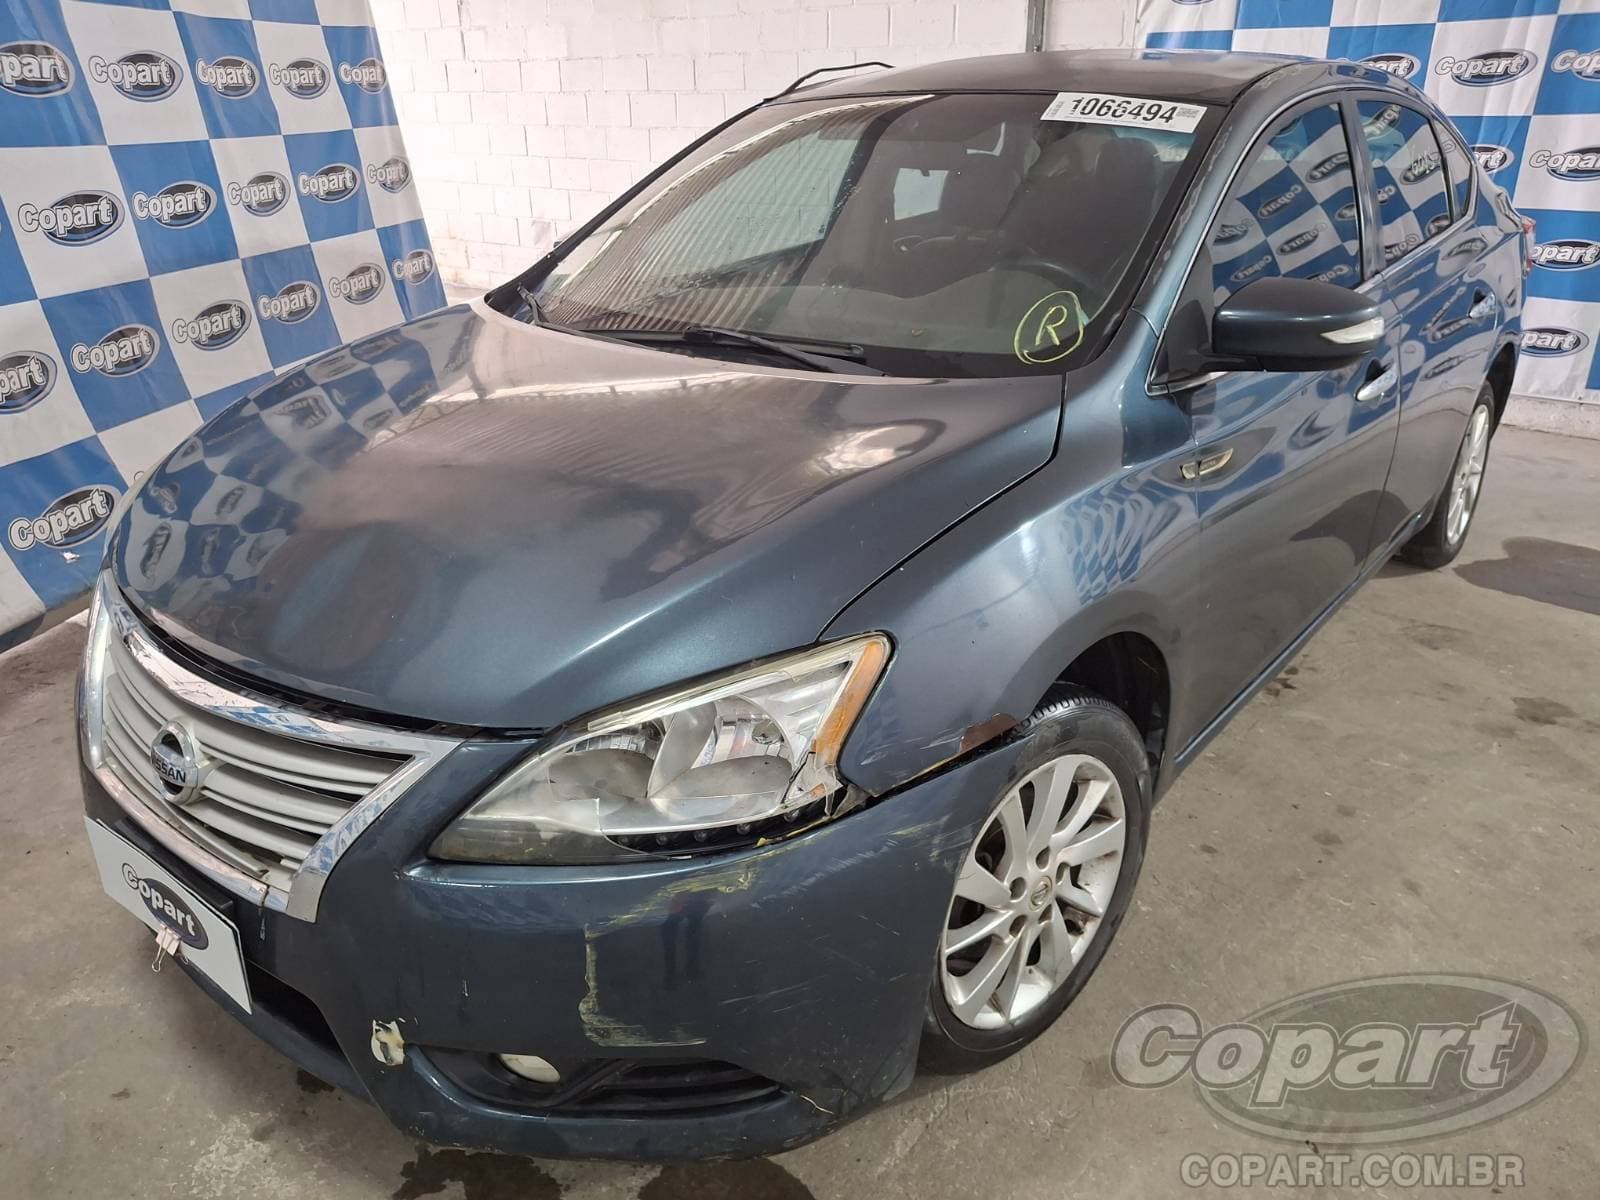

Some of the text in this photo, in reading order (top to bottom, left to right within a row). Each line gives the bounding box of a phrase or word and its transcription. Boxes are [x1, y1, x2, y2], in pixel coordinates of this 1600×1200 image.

[88, 52, 171, 88] Copart
[196, 57, 252, 90] Copart
[269, 59, 322, 87] Copart
[1435, 53, 1526, 80] Copart
[228, 178, 282, 208] Copart
[299, 167, 354, 196] Copart
[18, 194, 113, 236] Copart
[133, 182, 207, 221] Copart
[329, 264, 381, 298] Copart
[392, 250, 433, 280] Copart
[259, 282, 314, 320] Copart
[172, 304, 243, 343] Copart
[1035, 305, 1068, 346] R
[71, 329, 152, 372] Copart
[9, 489, 108, 550] Copart
[151, 752, 186, 784] NISSAN
[121, 862, 196, 936] Copart
